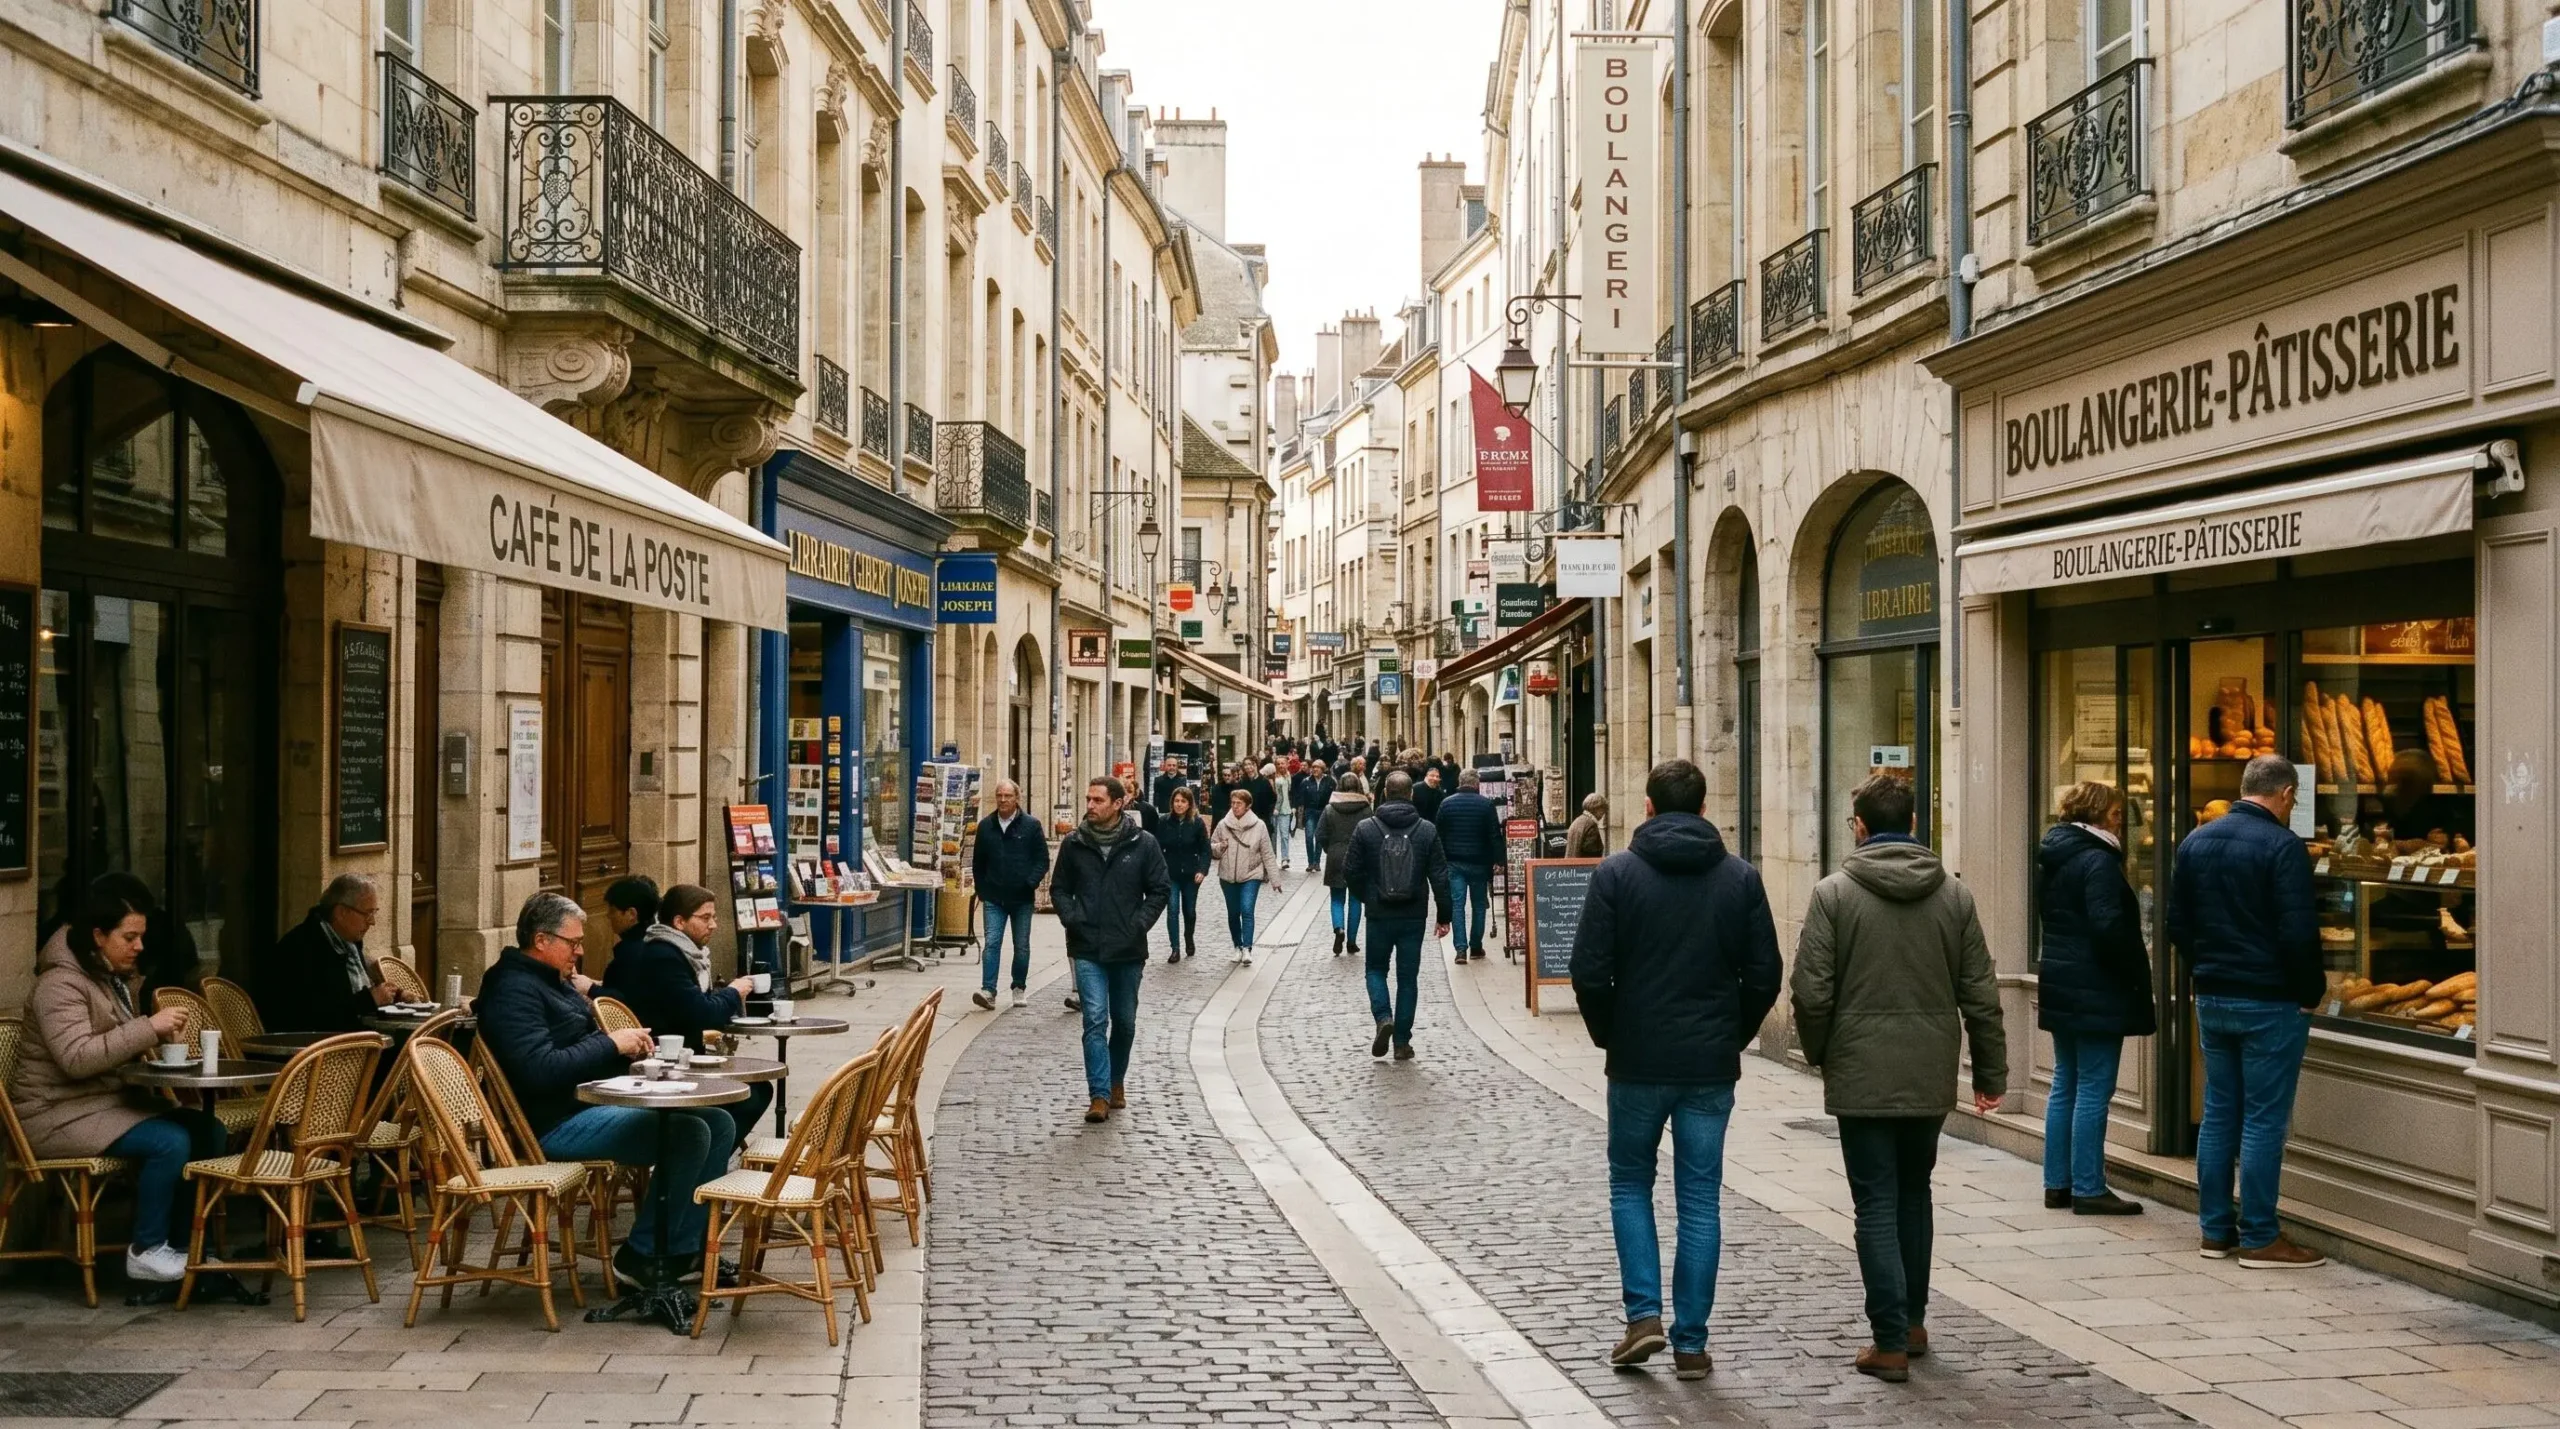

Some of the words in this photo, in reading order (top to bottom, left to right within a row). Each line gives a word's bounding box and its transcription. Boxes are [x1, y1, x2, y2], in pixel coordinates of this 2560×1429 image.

[1605, 58, 1628, 329] BOULANGERI
[2006, 284, 2459, 476] BOULANGERIE-PÂTISSERIE
[490, 494, 561, 573] CAFÉ
[570, 516, 601, 582] DE
[609, 528, 638, 591] LA
[645, 538, 710, 606] POSTE
[2053, 511, 2302, 579] BOULANGERIE-PÂTISSERIE
[894, 564, 930, 609] JOSEPH
[941, 601, 993, 611] JOSEPH
[1859, 582, 1931, 621] LIBRAIRIE
